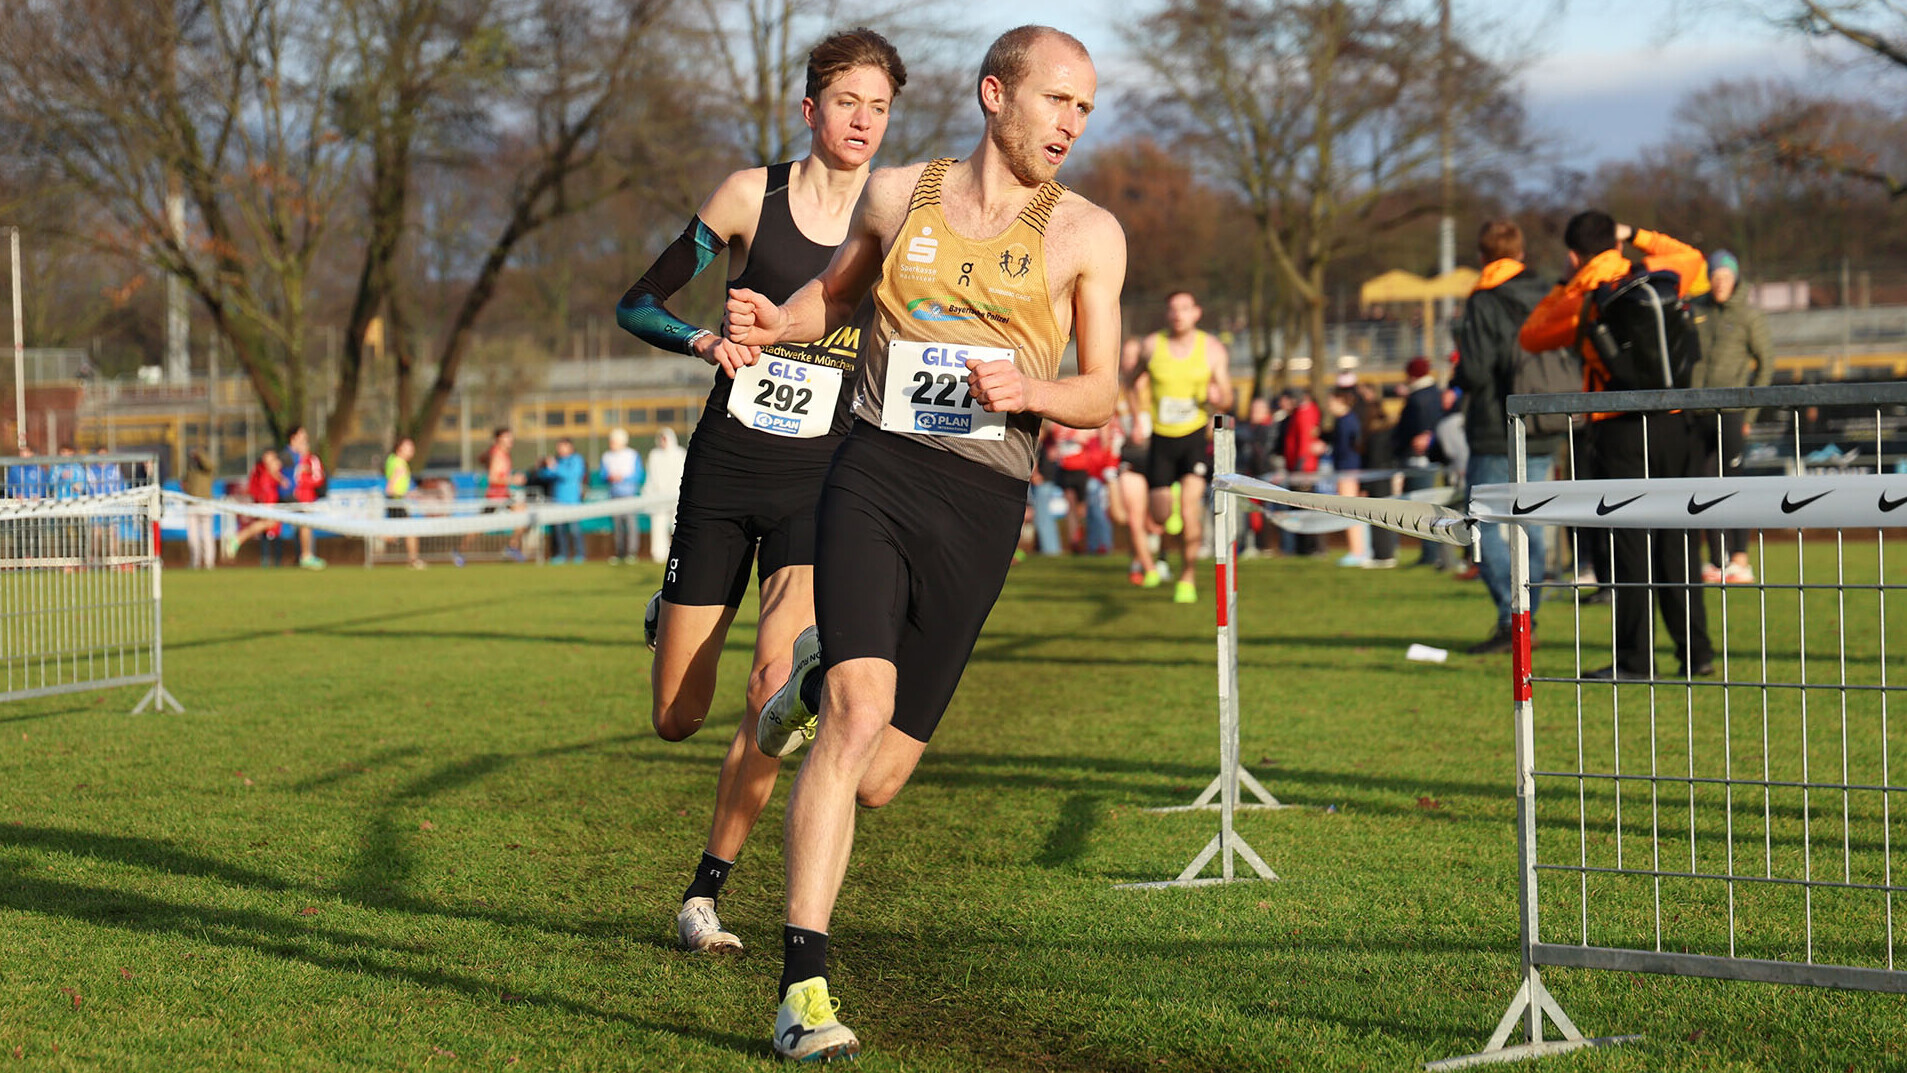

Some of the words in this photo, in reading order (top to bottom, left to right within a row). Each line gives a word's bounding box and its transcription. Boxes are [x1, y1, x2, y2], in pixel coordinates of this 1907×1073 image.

[948, 304, 986, 318] Bayerische
[986, 312, 1010, 324] Polizei
[813, 354, 855, 372] München
[753, 378, 813, 415] 292
[910, 371, 973, 409] 227
[773, 417, 799, 430] PLAN
[937, 415, 969, 428] PLAN
